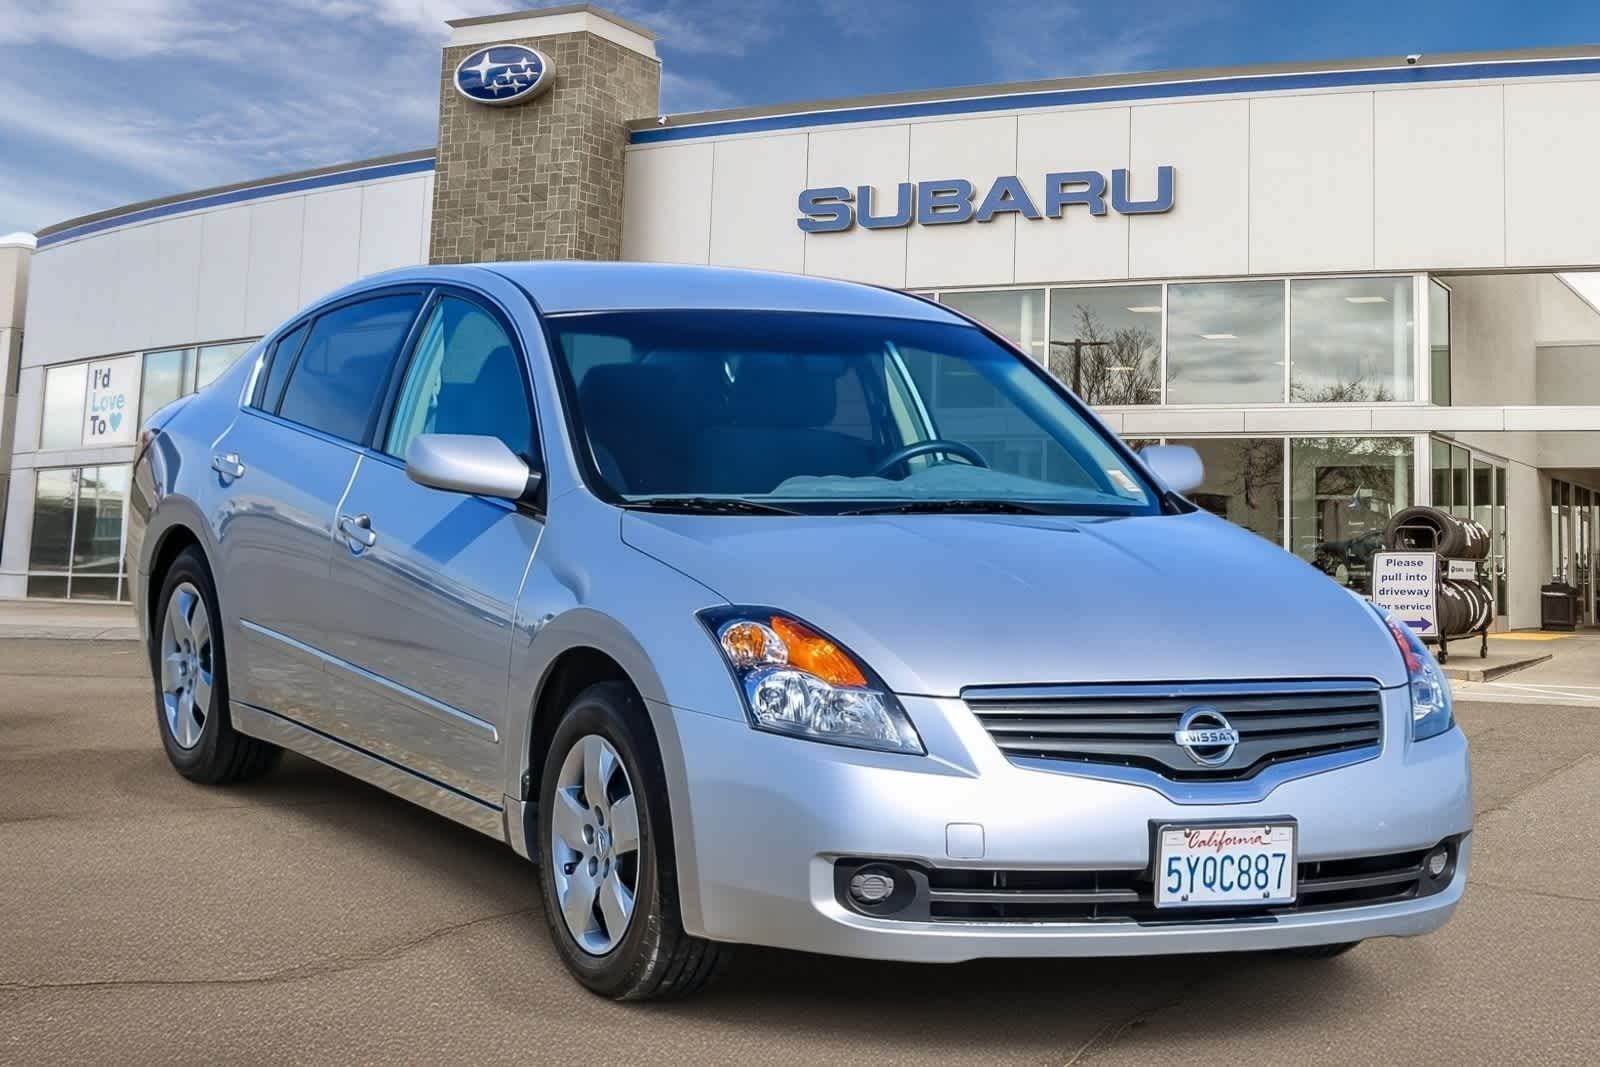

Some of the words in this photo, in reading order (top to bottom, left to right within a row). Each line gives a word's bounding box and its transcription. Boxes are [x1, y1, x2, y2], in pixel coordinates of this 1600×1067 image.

[797, 165, 1176, 233] SUBARU
[93, 368, 111, 389] I'd
[92, 391, 125, 412] Love
[90, 415, 107, 435] To
[1386, 559, 1424, 567] Please
[1381, 573, 1402, 583] pull
[1405, 573, 1428, 582] into
[1378, 587, 1430, 598] driveway
[1394, 602, 1432, 610] service
[1185, 731, 1235, 743] NISSAN
[1188, 830, 1272, 853] California
[1167, 853, 1286, 894] 5YQC887
